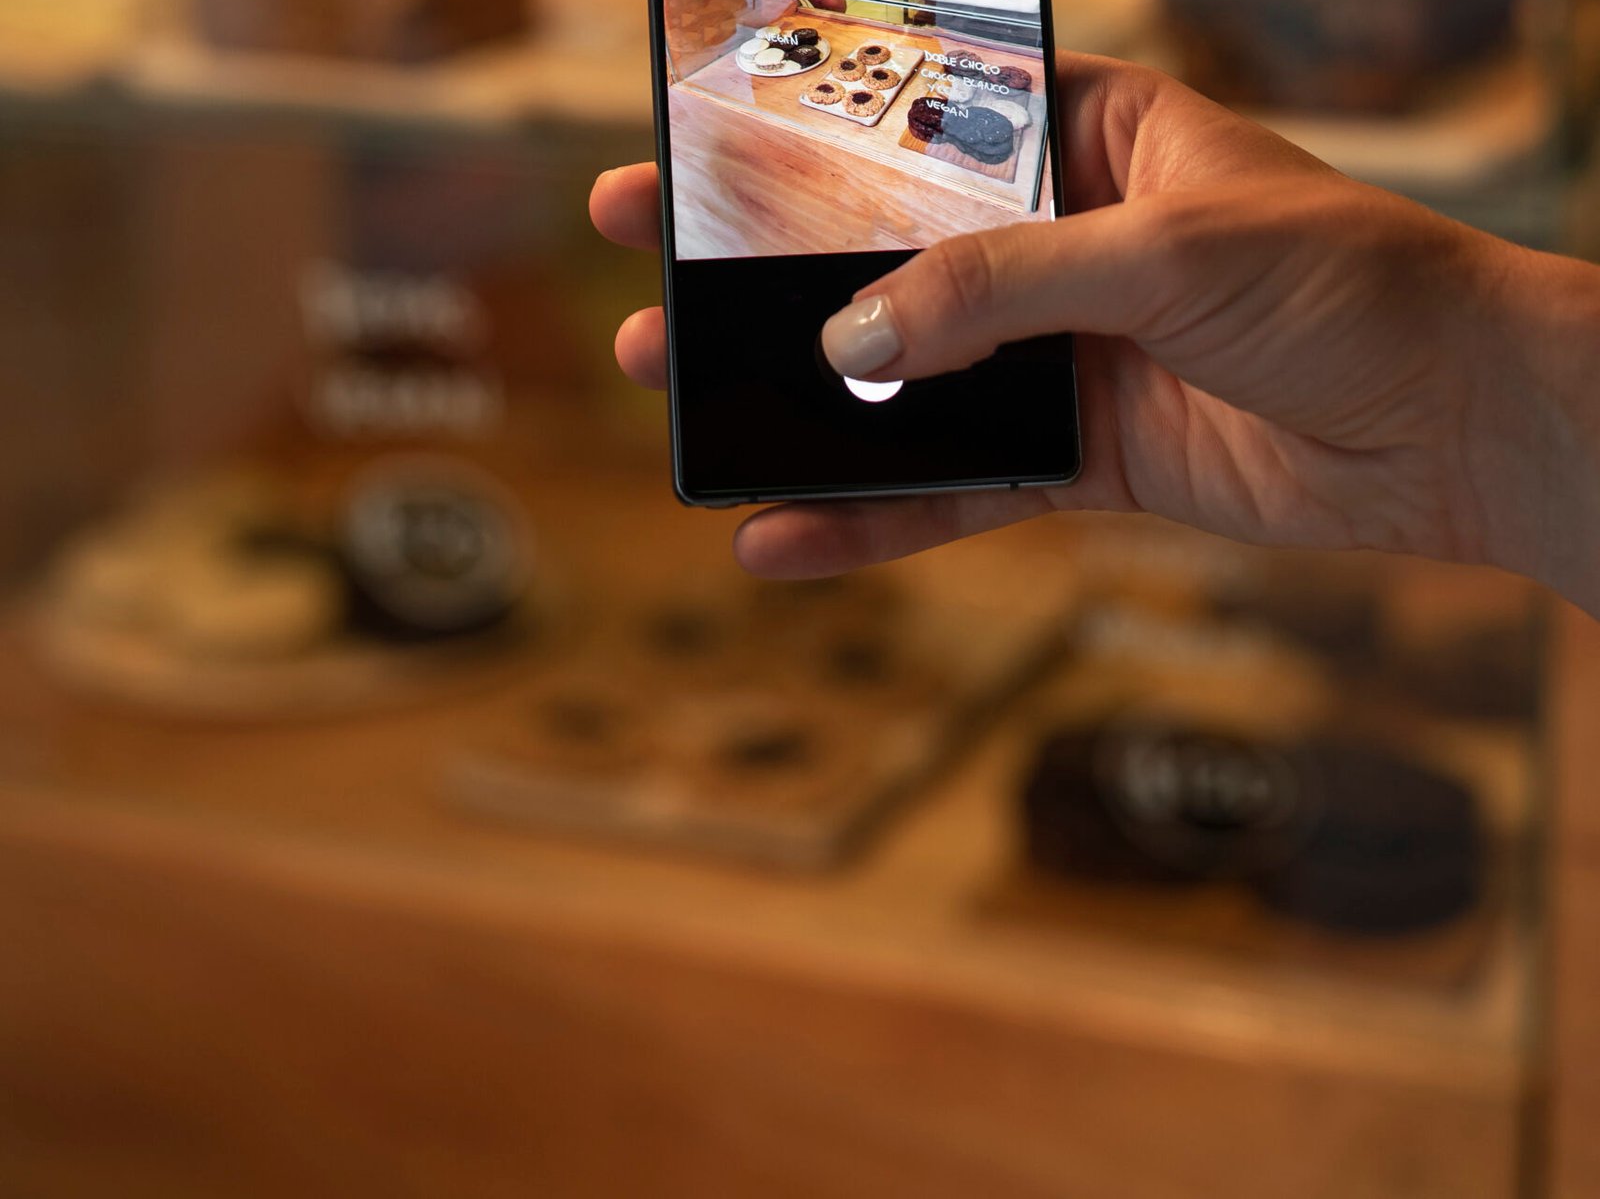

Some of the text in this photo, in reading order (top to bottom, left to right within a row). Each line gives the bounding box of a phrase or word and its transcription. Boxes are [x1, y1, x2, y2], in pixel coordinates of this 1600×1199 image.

[765, 33, 799, 46] VEGAN
[924, 50, 1000, 75] DOBLE CHOCO
[920, 68, 1010, 95] CHOCO BLANCO
[926, 99, 969, 119] VEGAN
